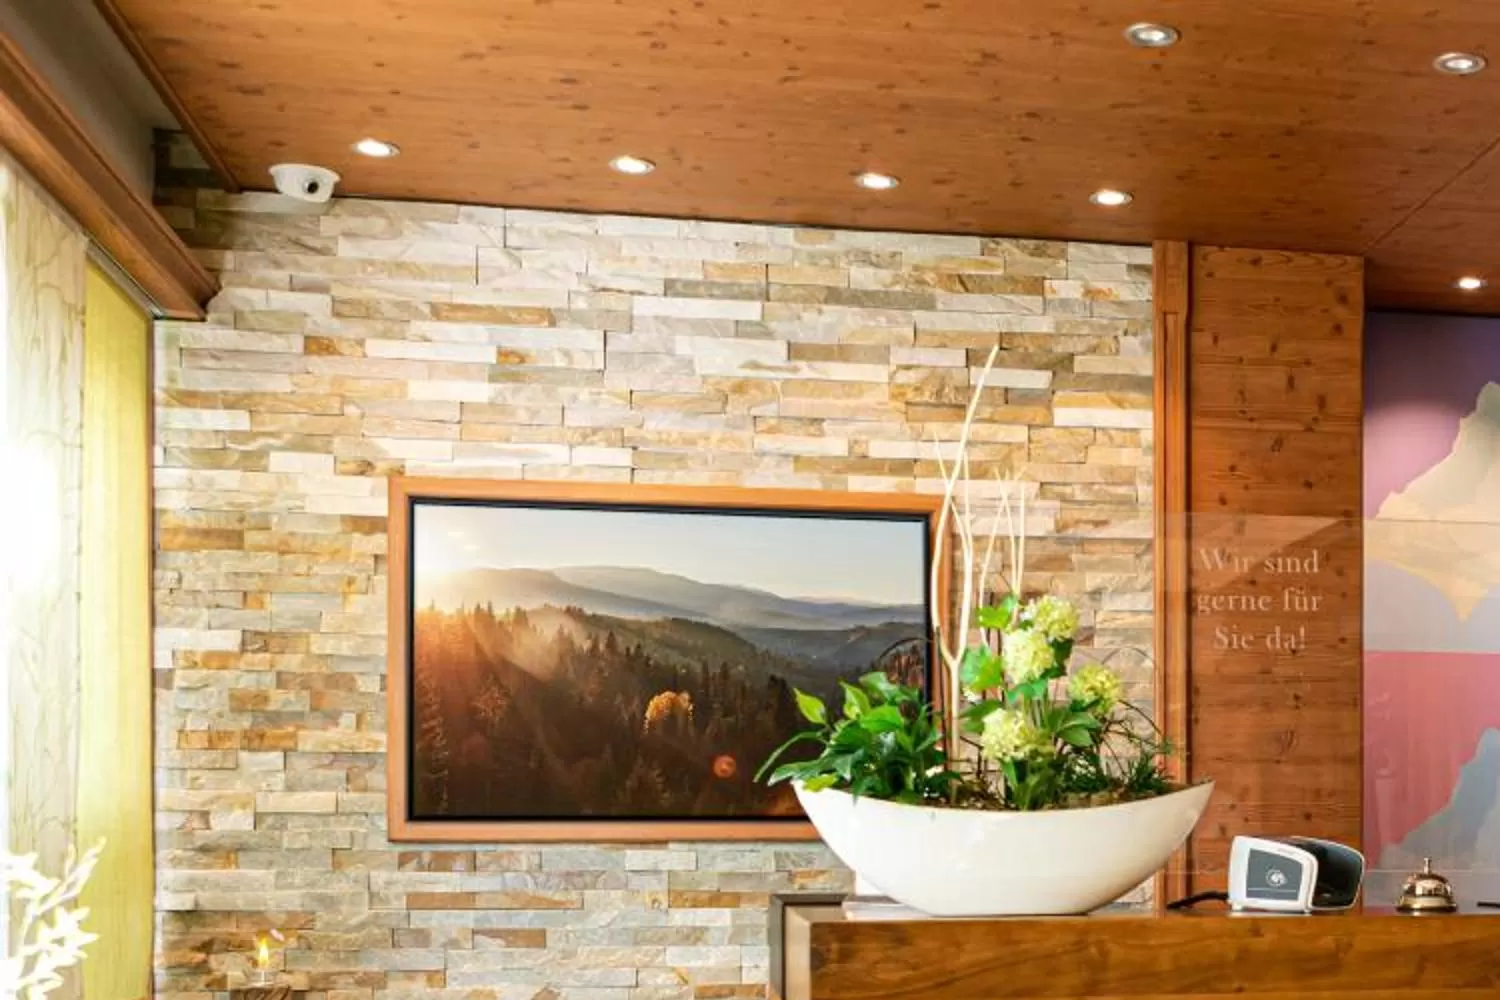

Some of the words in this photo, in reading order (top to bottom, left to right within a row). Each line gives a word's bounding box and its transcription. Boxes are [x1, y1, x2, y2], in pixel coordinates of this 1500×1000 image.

[1200, 548, 1252, 573] Wir
[1263, 548, 1320, 573] sind
[1197, 594, 1272, 615] gerne
[1282, 586, 1323, 613] für
[1213, 623, 1254, 650] Sie
[1265, 624, 1306, 650] da!
